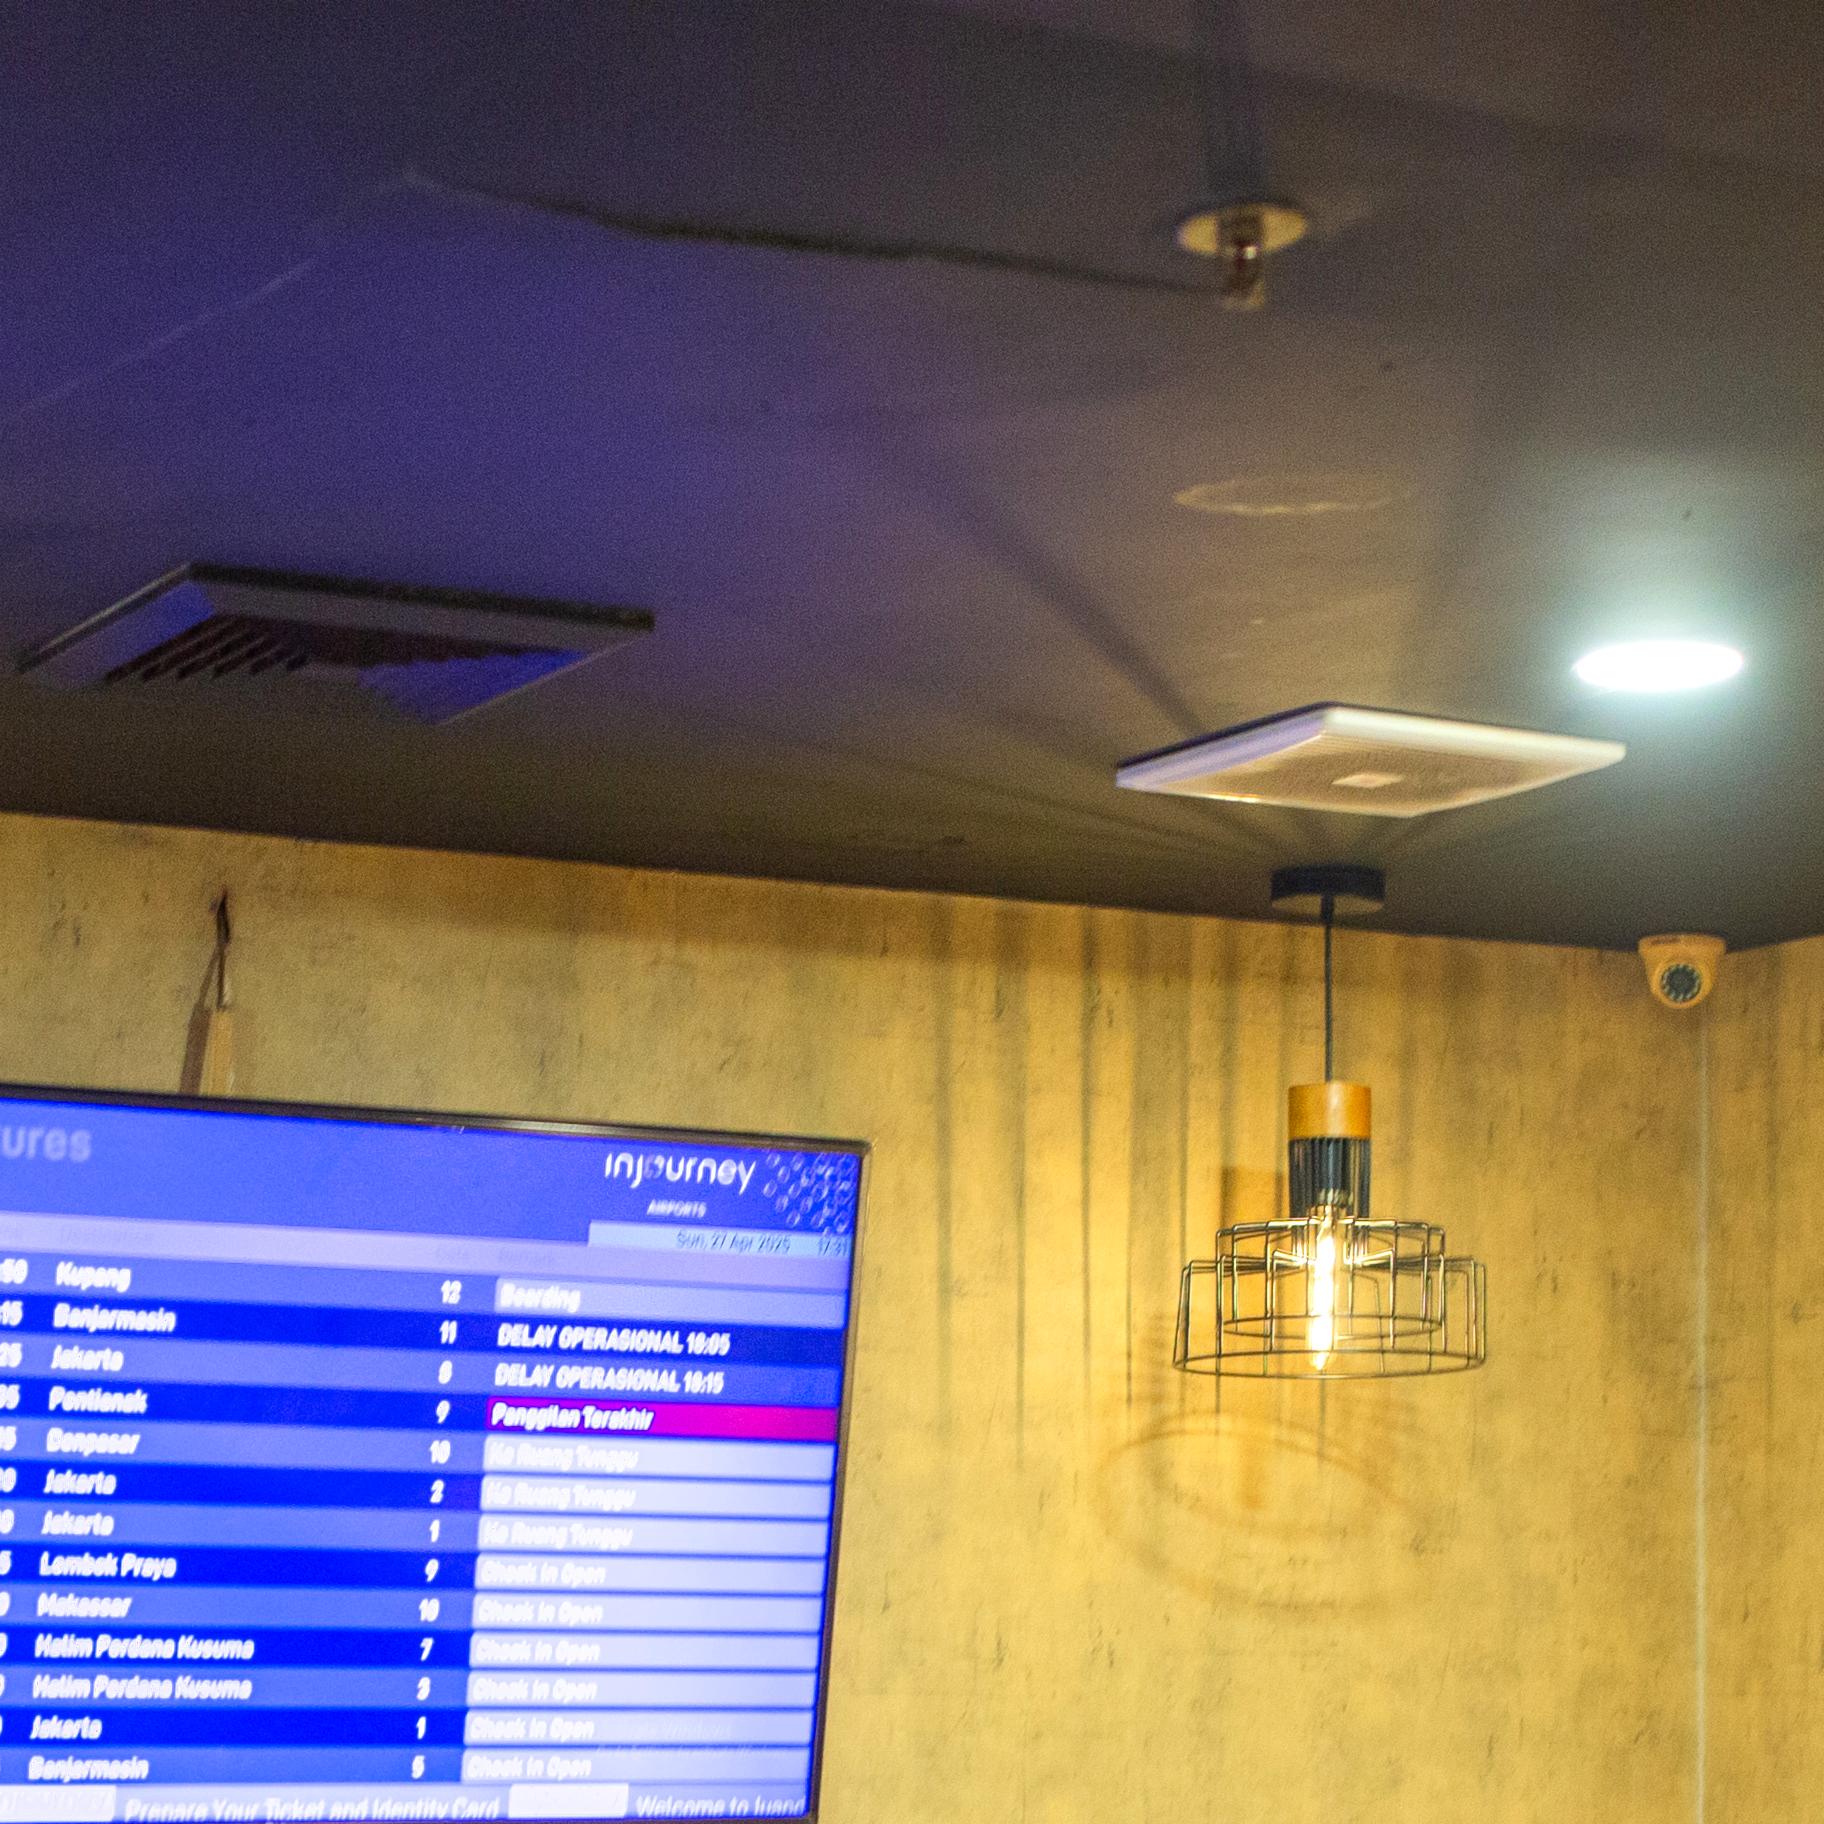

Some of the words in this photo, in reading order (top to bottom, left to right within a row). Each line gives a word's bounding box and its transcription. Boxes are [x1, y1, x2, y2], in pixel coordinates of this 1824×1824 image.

[56, 1262, 131, 1292] Kupang
[498, 1283, 581, 1314] Boarding
[53, 1303, 176, 1332] Banjarmasin
[440, 1321, 457, 1344] 11
[498, 1323, 557, 1348] DELAY
[559, 1326, 683, 1353] OPERASIONAL
[51, 1345, 123, 1371] Jakarta
[495, 1363, 554, 1387] DELAY
[556, 1365, 680, 1392] OPERASIONAL
[49, 1386, 147, 1413] Pontianak
[436, 1400, 450, 1423] 9
[492, 1403, 580, 1431] Panggilan
[579, 1406, 654, 1430] Terakhir
[47, 1428, 140, 1456] Denpasar
[44, 1469, 116, 1494] Jakarta
[430, 1480, 444, 1503] 2
[42, 1511, 114, 1536] Jakarta
[430, 1520, 440, 1542] 1
[40, 1552, 118, 1576] Lombok
[121, 1553, 176, 1580] Praya
[425, 1559, 439, 1581] 9
[479, 1561, 537, 1584] Check
[561, 1562, 606, 1588] Open
[37, 1593, 132, 1617] Makassar
[477, 1599, 534, 1622] Check
[558, 1600, 604, 1626] Open
[35, 1634, 93, 1657] Halim
[96, 1634, 175, 1658] Perdana
[177, 1636, 254, 1659] Kusuma
[421, 1638, 433, 1660] 7
[475, 1637, 531, 1661] Check
[555, 1638, 601, 1666] Open
[33, 1675, 91, 1698] Halim
[93, 1675, 172, 1699] Perdana
[175, 1676, 252, 1699] Kusuma
[472, 1677, 529, 1700] Check
[552, 1677, 598, 1704] Open
[30, 1716, 102, 1739] Jakarta
[417, 1717, 426, 1739] 1
[470, 1716, 526, 1739] Check
[549, 1717, 595, 1743] Open
[29, 1756, 149, 1783] Banjarmasin
[467, 1754, 525, 1777] Check
[547, 1755, 592, 1781] Open
[328, 1798, 369, 1819] and
[636, 1795, 726, 1816] Welcome
[729, 1796, 750, 1815] to
